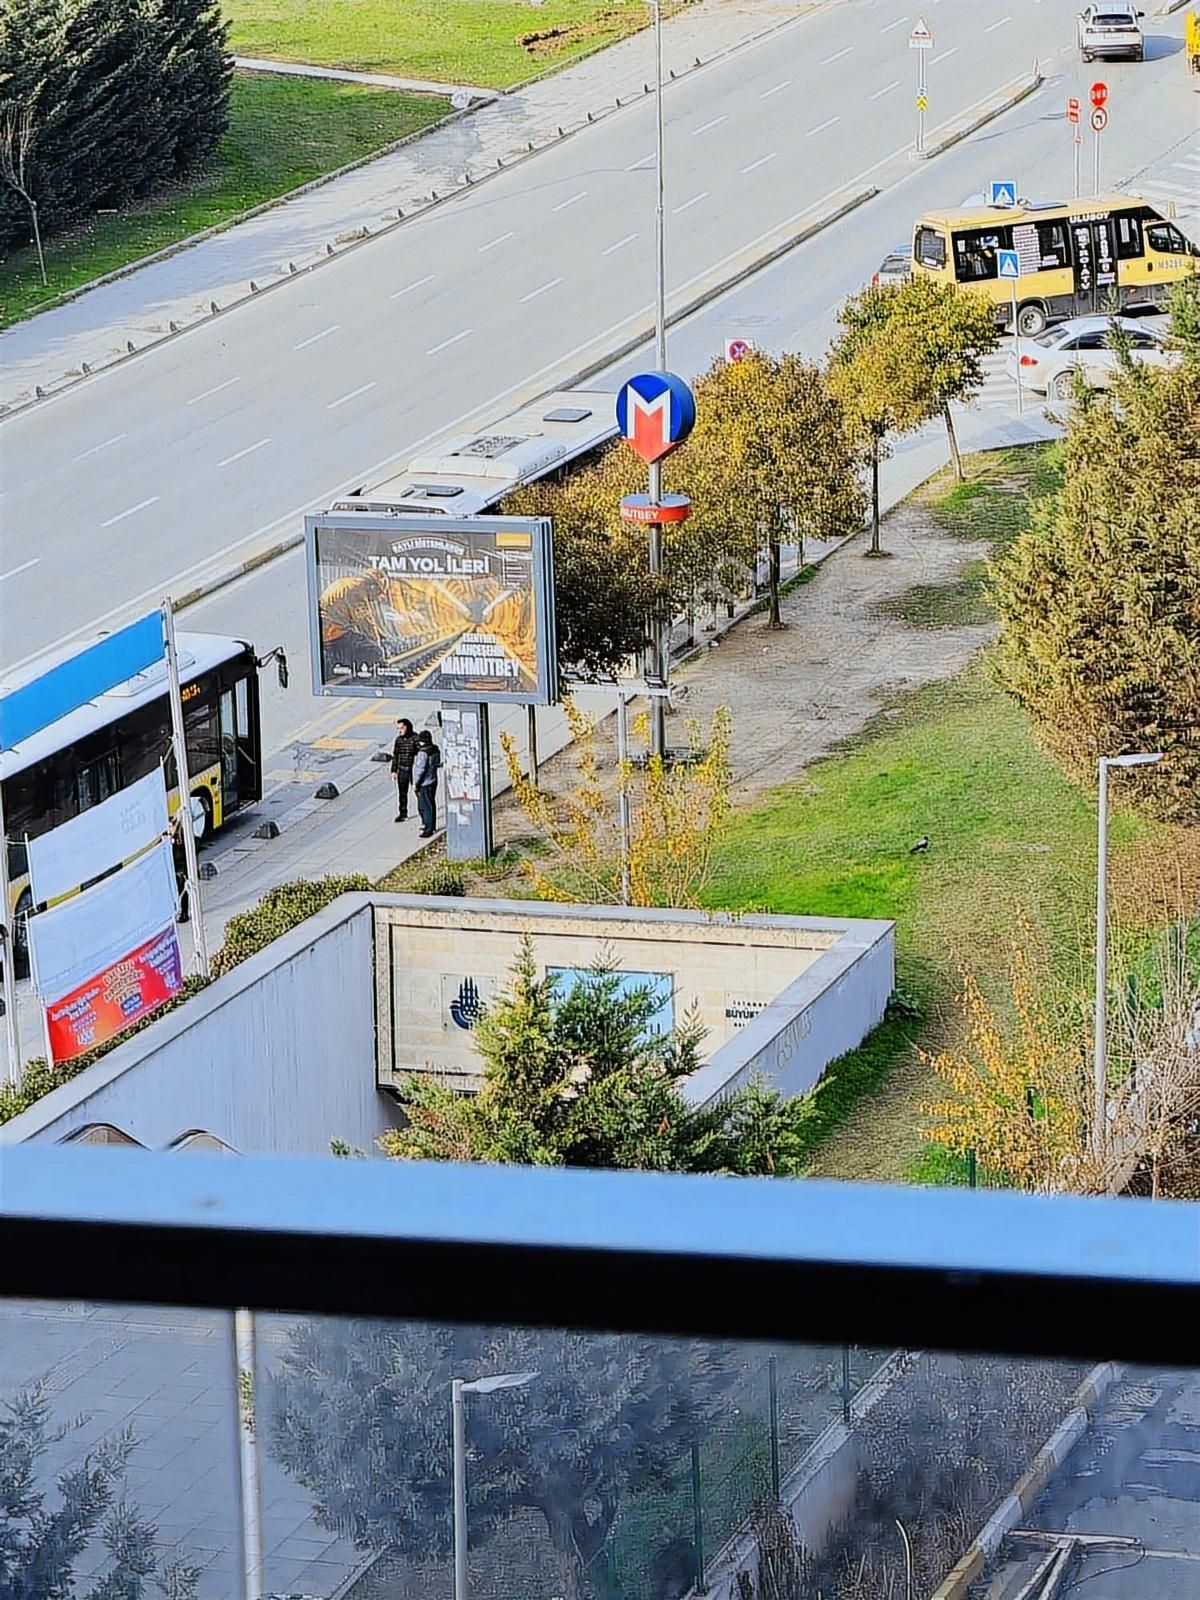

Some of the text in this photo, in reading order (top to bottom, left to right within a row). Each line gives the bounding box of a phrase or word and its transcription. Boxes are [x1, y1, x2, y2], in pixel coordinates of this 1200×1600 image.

[1069, 212, 1110, 223] ULUSOY
[368, 556, 406, 571] TAM
[409, 556, 444, 572] YOL
[447, 554, 489, 574] İLERİ
[441, 656, 519, 677] MAHMUTBEY
